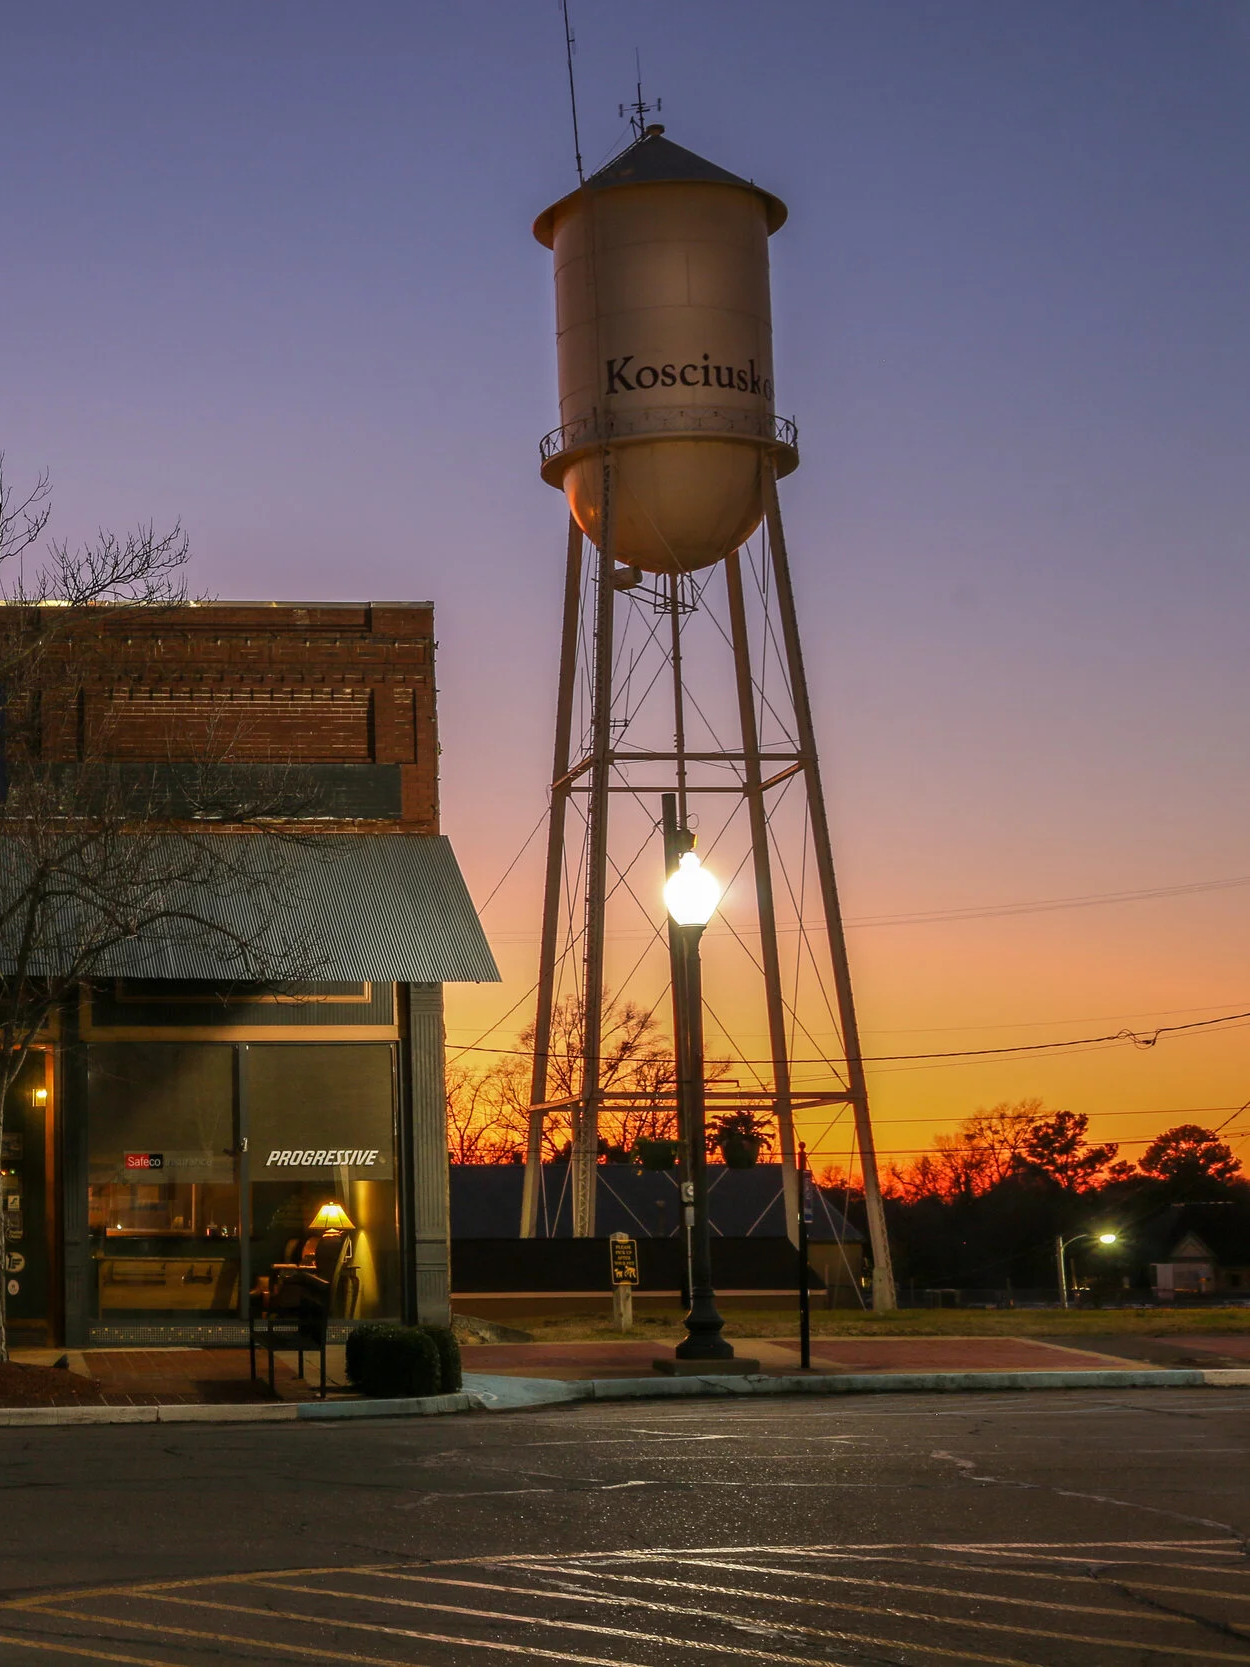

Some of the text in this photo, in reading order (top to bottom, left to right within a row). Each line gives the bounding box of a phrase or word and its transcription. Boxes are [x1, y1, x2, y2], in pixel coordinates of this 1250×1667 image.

[605, 353, 773, 401] Kosciusko
[127, 1156, 161, 1167] Safeco
[265, 1149, 380, 1166] PROGRESSIVE
